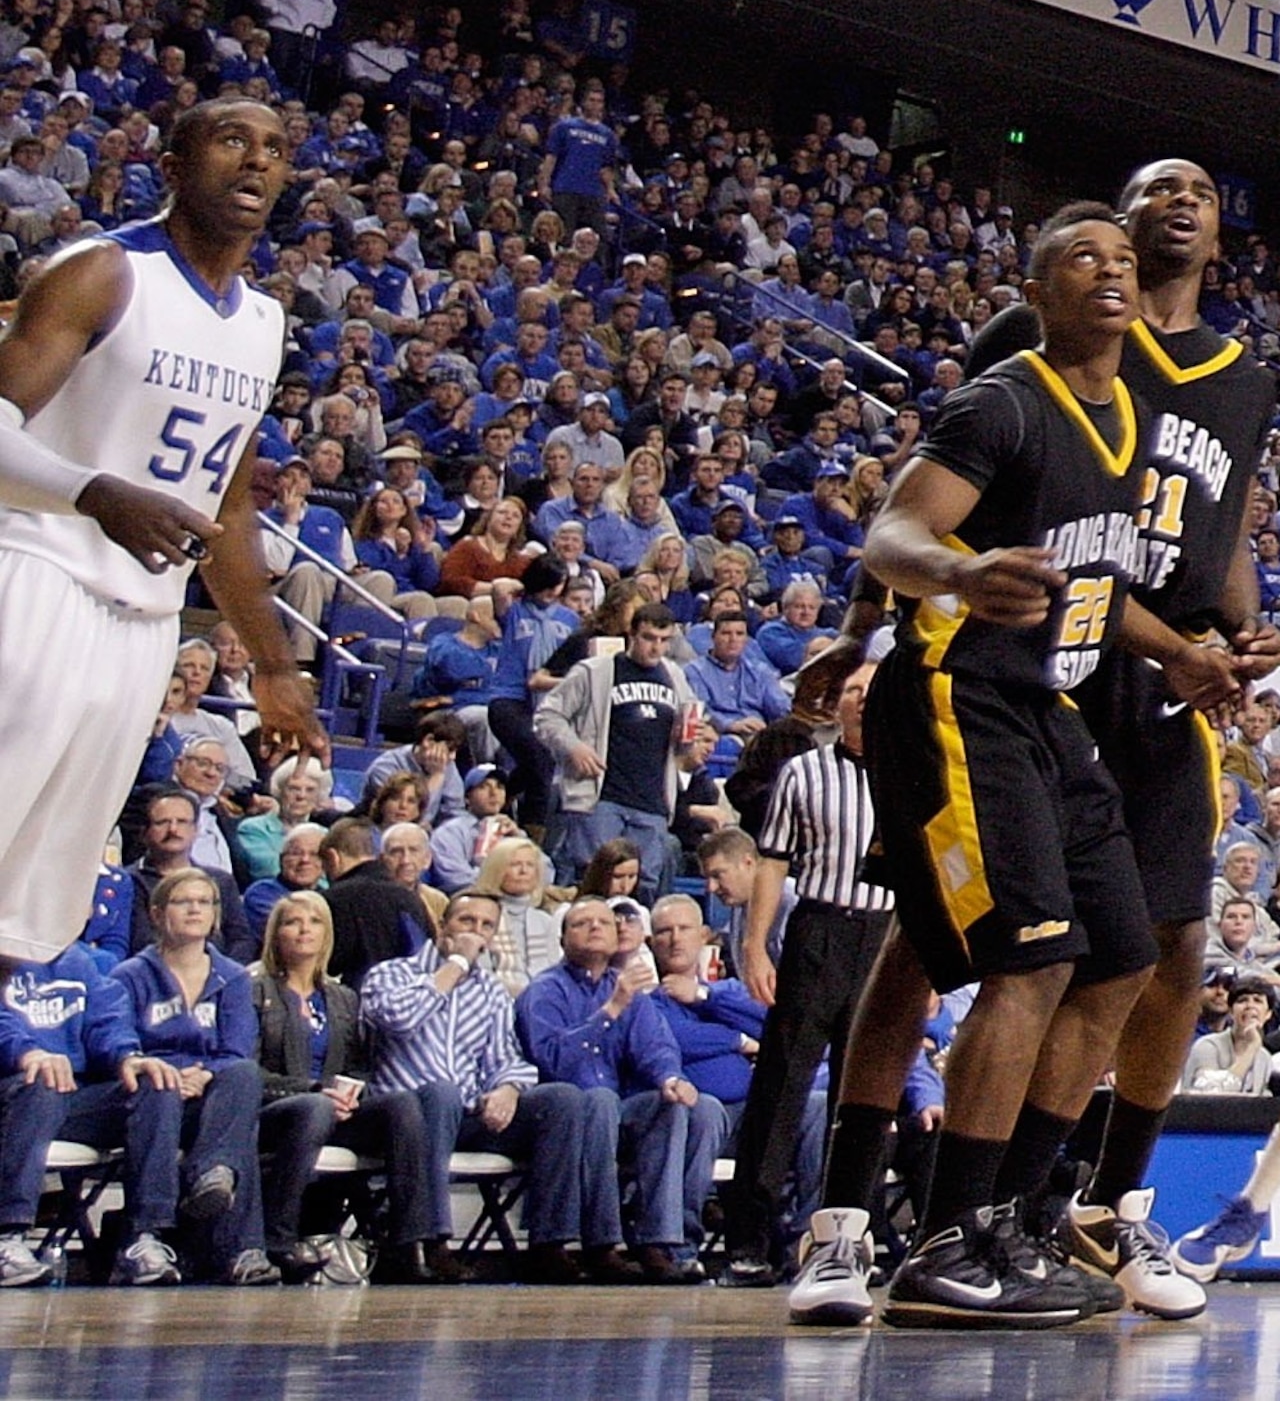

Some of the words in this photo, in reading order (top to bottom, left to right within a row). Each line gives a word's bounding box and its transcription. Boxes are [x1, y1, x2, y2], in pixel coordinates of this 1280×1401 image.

[589, 9, 628, 50] 15
[1221, 183, 1249, 217] 16
[148, 404, 244, 495] 54
[1153, 411, 1233, 503] BEACH
[1136, 466, 1189, 539] 21
[1042, 512, 1106, 572] LONG
[1131, 536, 1182, 589] ATE
[1058, 574, 1115, 647] 22
[611, 681, 677, 709] KENTUCK
